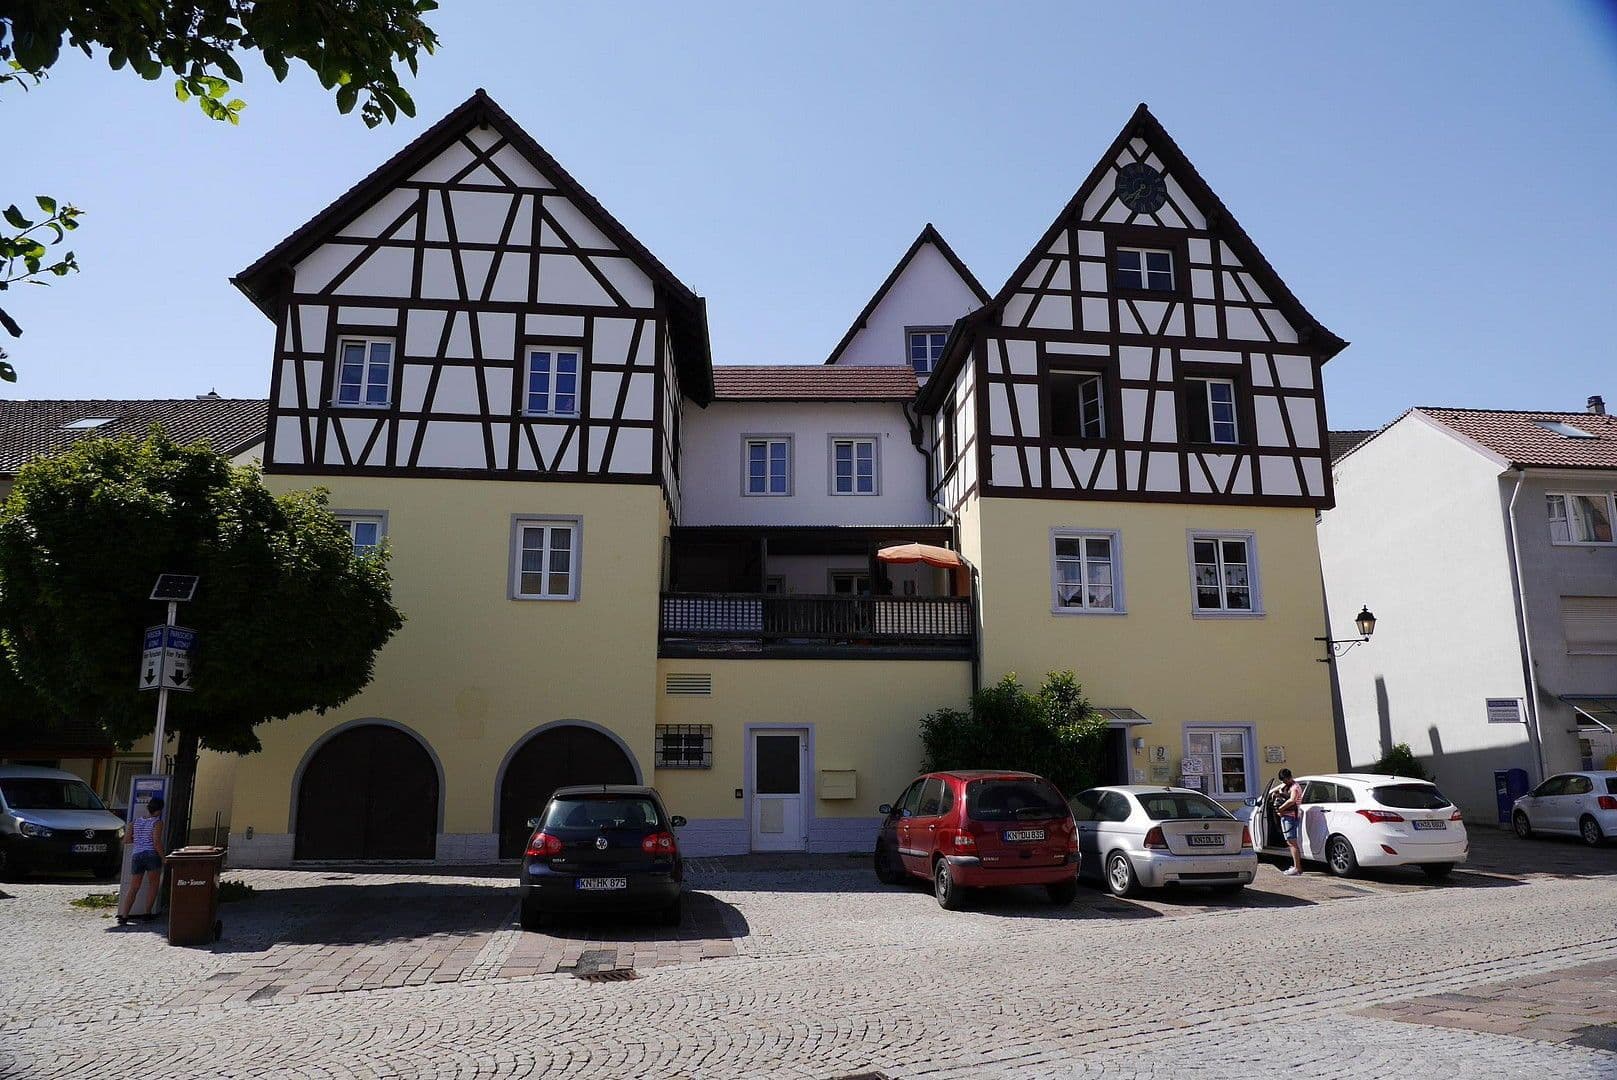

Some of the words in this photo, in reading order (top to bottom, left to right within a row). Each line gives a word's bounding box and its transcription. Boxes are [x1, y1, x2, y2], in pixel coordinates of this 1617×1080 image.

[580, 879, 592, 888] KN
[597, 879, 608, 888] HK
[610, 878, 626, 887] 875
